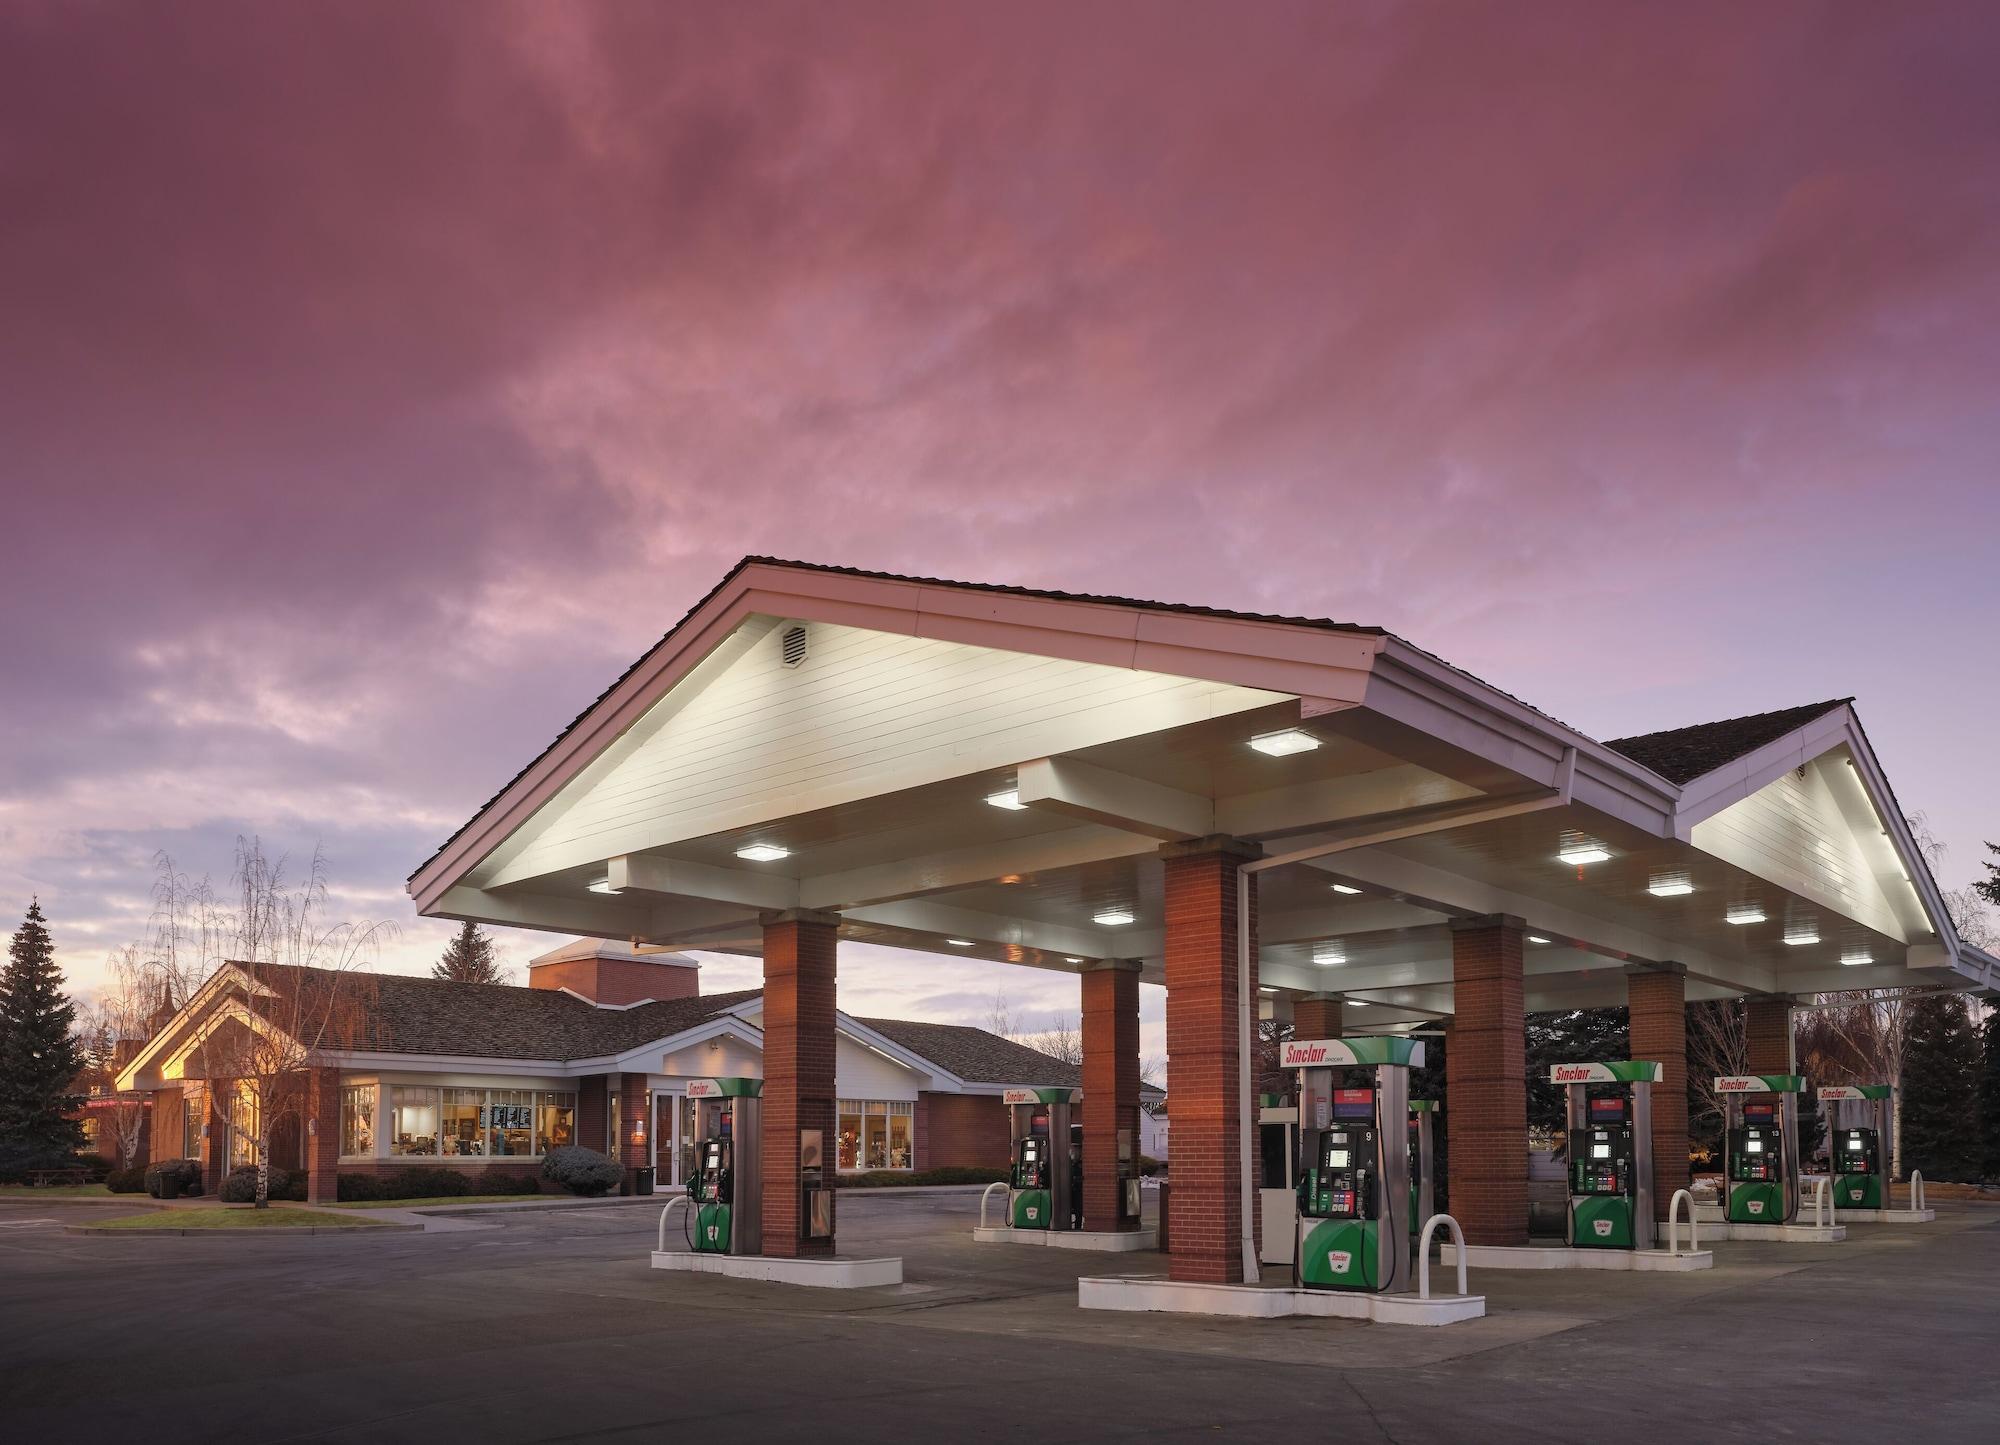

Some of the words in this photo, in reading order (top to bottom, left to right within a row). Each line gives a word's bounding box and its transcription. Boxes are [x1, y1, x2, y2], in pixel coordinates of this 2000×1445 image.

[1286, 1043, 1327, 1063] Sinclair
[1556, 1066, 1590, 1080] Sinclair
[688, 1081, 709, 1096] Sinclair
[1719, 1078, 1749, 1090] Sinclair
[1006, 1091, 1026, 1102] Sinclair
[1821, 1088, 1847, 1099] Sinclair
[1365, 1131, 1372, 1141] 9
[1622, 1130, 1630, 1138] 11
